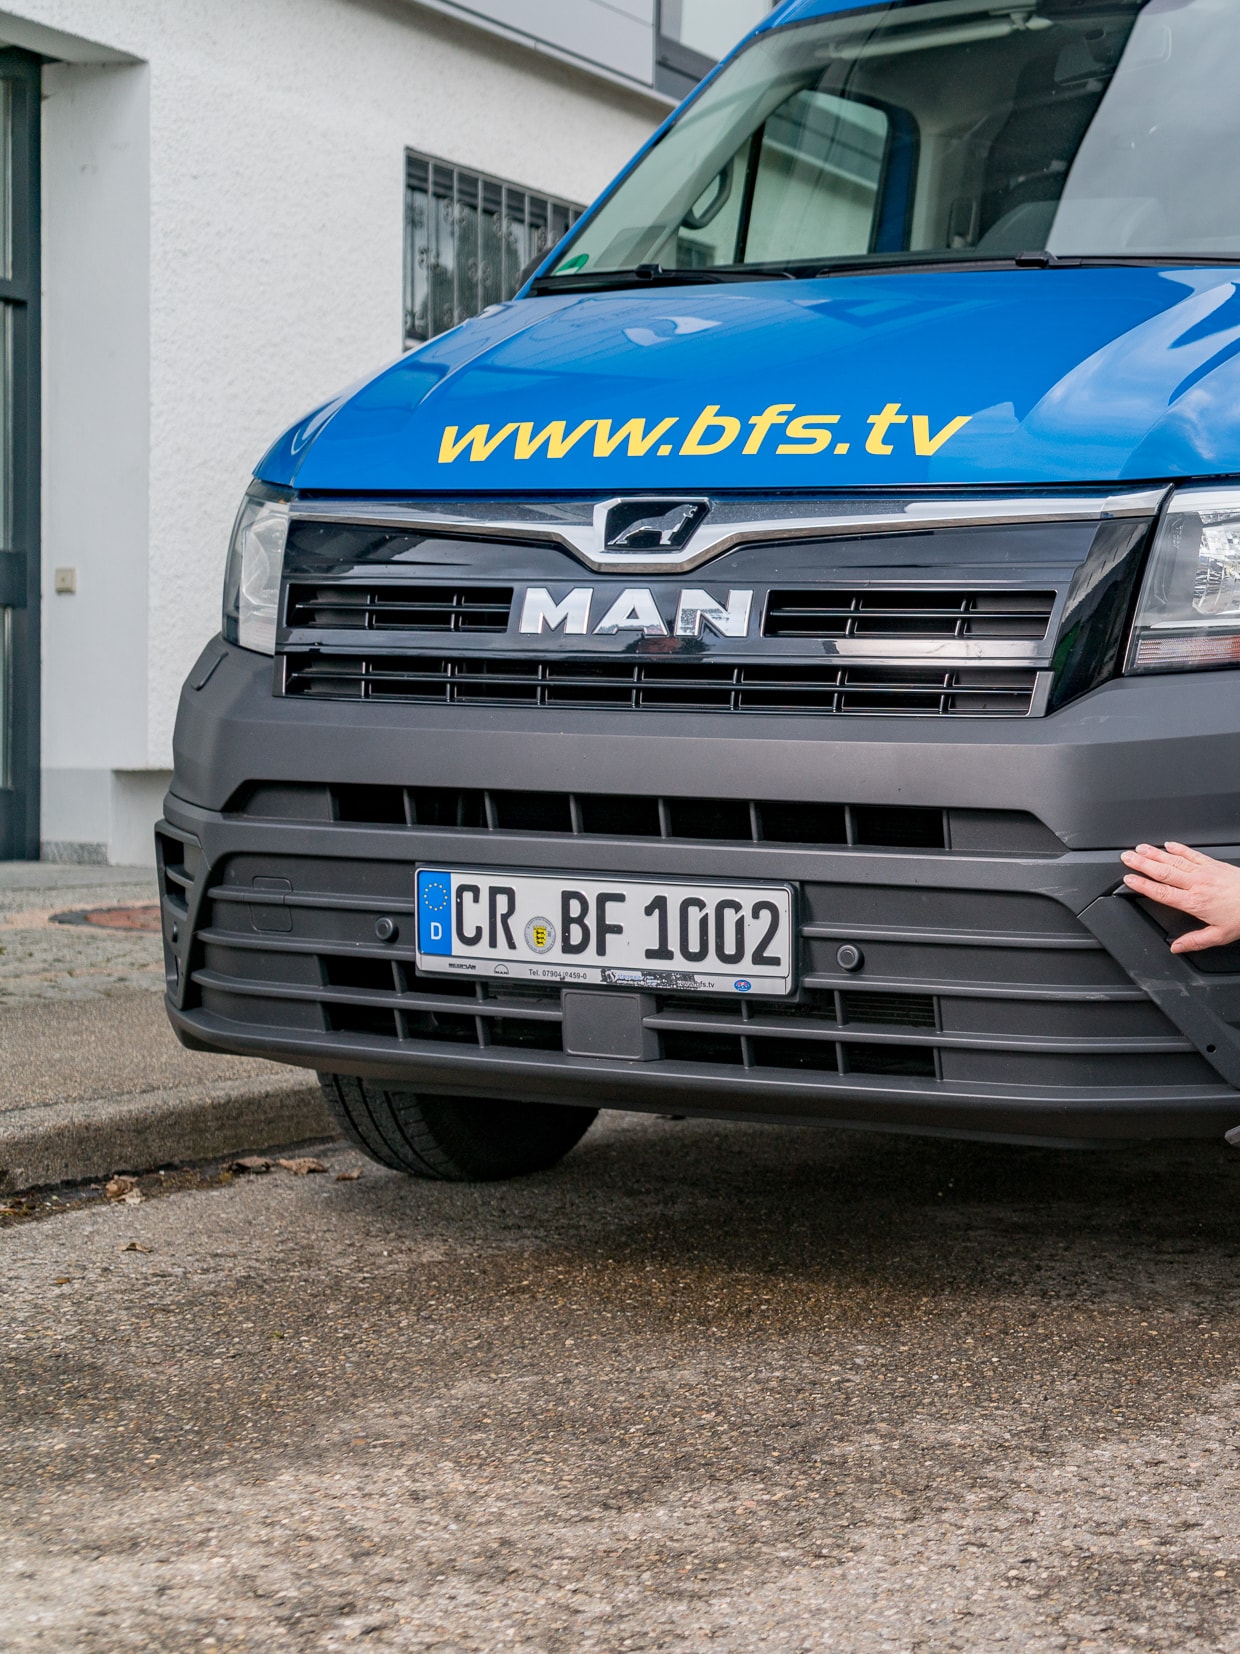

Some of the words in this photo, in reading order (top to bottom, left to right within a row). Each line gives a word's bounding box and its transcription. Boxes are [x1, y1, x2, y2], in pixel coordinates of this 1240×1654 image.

[437, 403, 973, 464] www.bfs.tv
[518, 587, 754, 638] MAN
[430, 922, 442, 940] D
[454, 883, 517, 950] CR
[560, 889, 627, 957] BF
[643, 895, 782, 968] 1002
[528, 968, 541, 977] Tel.
